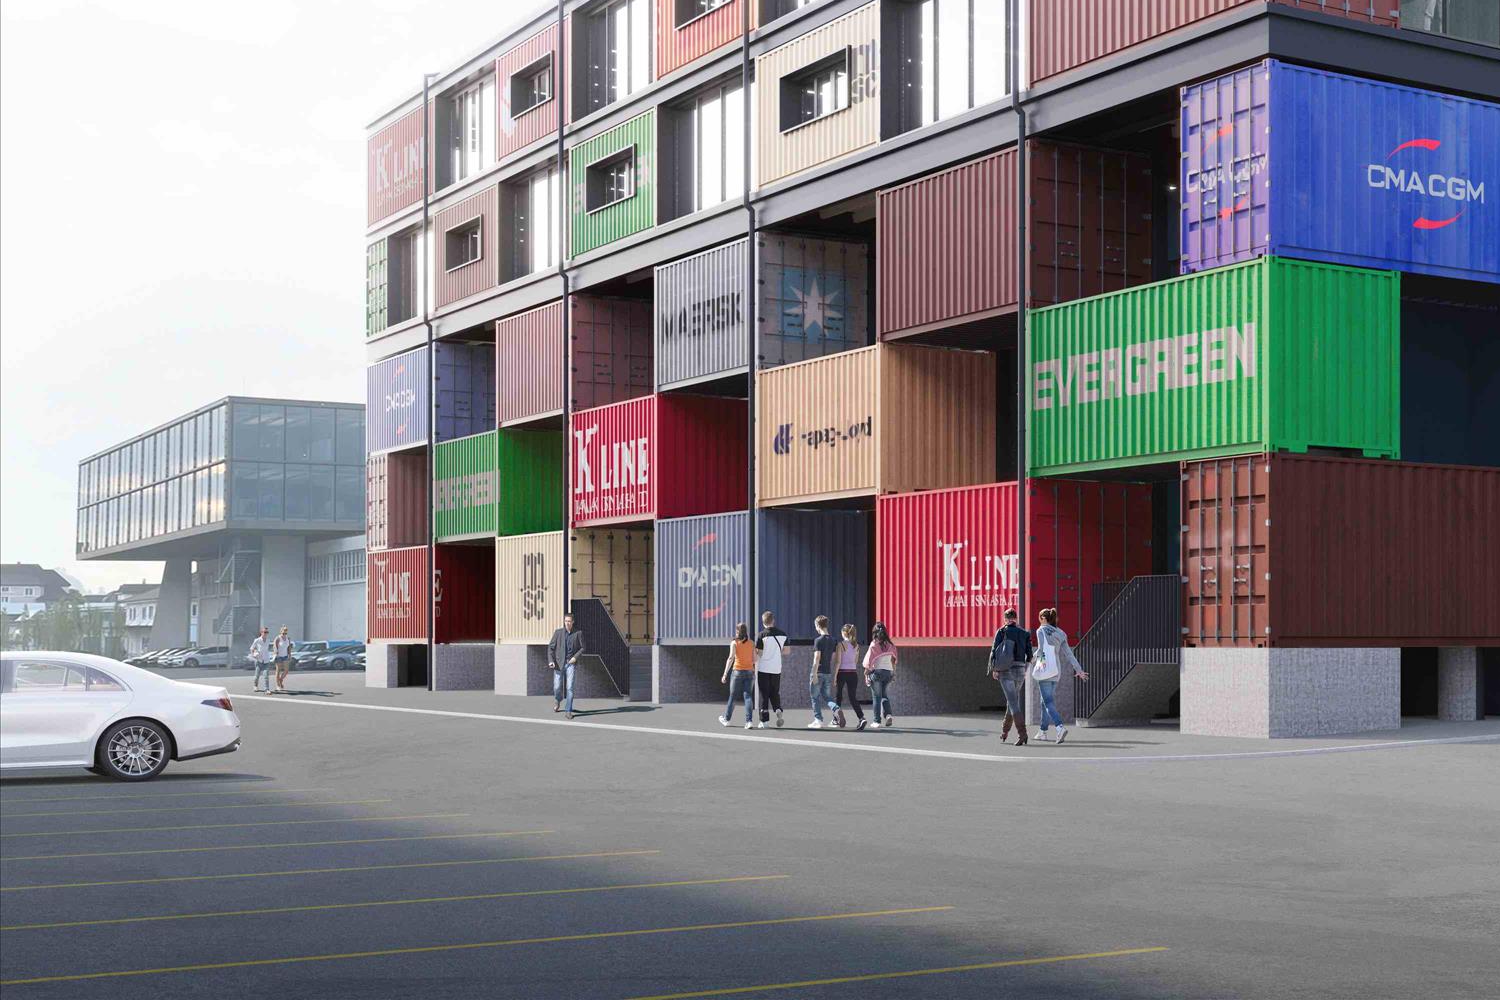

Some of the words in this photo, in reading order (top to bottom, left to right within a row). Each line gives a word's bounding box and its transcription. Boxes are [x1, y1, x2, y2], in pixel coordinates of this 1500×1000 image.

[1367, 163, 1425, 196] CMA
[1428, 173, 1485, 204] CGM
[1033, 322, 1255, 411] EVERGREEN
[601, 437, 650, 489] LINE
[971, 553, 1019, 591] LINE
